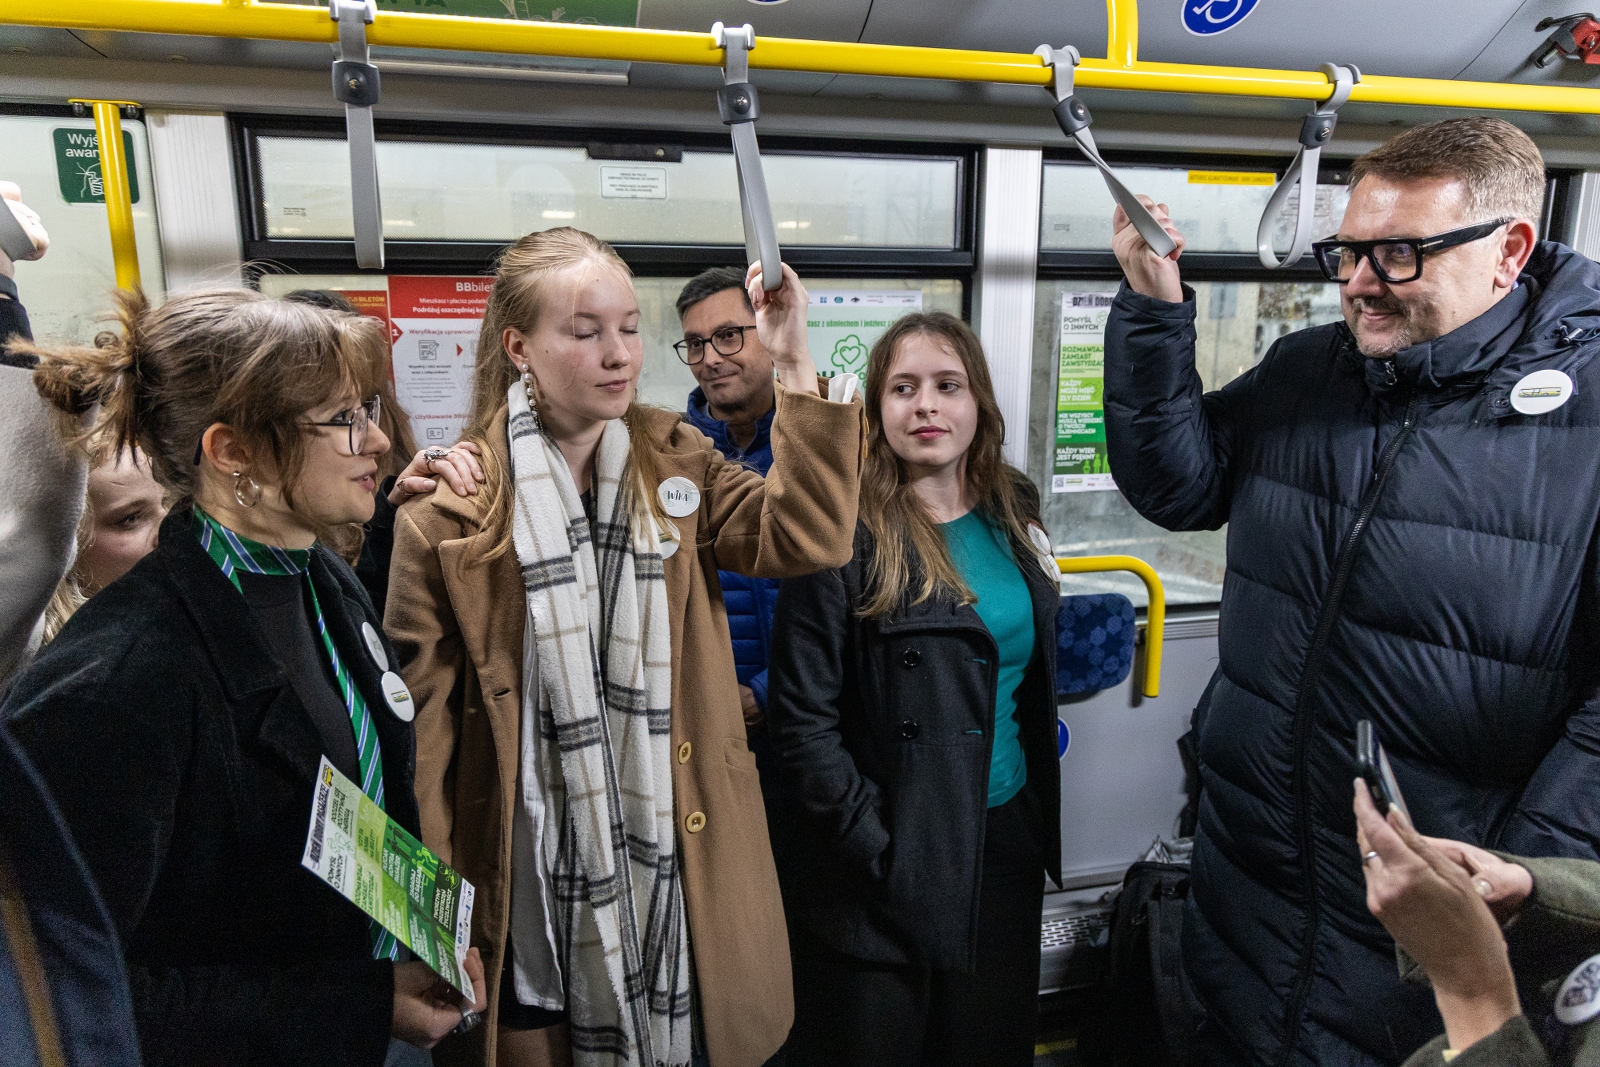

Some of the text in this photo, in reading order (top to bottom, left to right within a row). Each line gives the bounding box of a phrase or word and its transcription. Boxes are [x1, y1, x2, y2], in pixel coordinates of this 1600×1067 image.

[67, 133, 99, 148] Wyjś
[1072, 295, 1114, 307] DZIEŃ DOBR
[412, 306, 440, 314] Podróżuj
[440, 306, 475, 315] oszczędniej
[826, 319, 859, 328] uśmiechem
[864, 320, 886, 328] jedziesz
[1063, 315, 1092, 323] POMYŚL
[392, 328, 399, 336] 1
[1056, 446, 1078, 454] KAŻDY
[313, 818, 324, 842] DOBRY
[309, 839, 321, 863] DZIEŃ
[327, 854, 336, 883] POMYŚL
[335, 854, 343, 881] INNYCH
